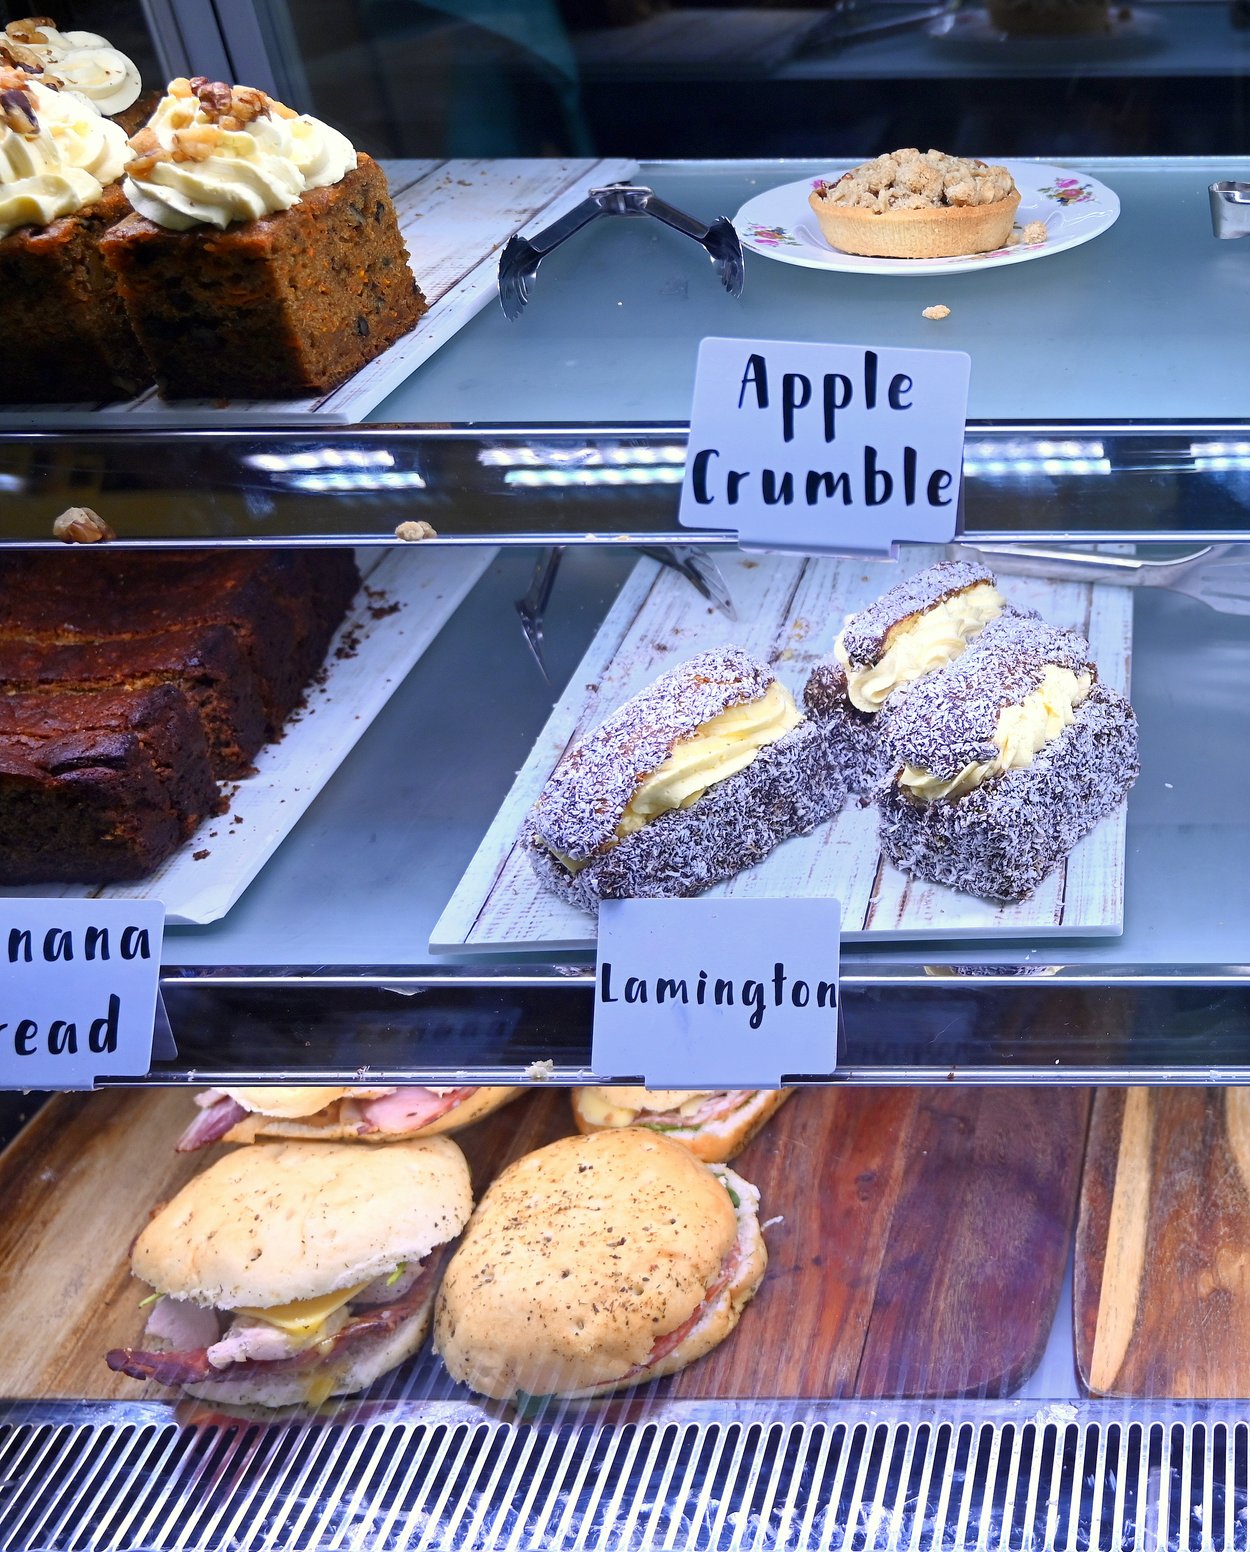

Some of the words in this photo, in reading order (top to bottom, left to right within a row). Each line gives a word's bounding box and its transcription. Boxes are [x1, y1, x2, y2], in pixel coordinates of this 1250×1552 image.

[738, 350, 913, 444] Apple
[692, 445, 953, 507] Crumble
[601, 962, 837, 1030] Lamington
